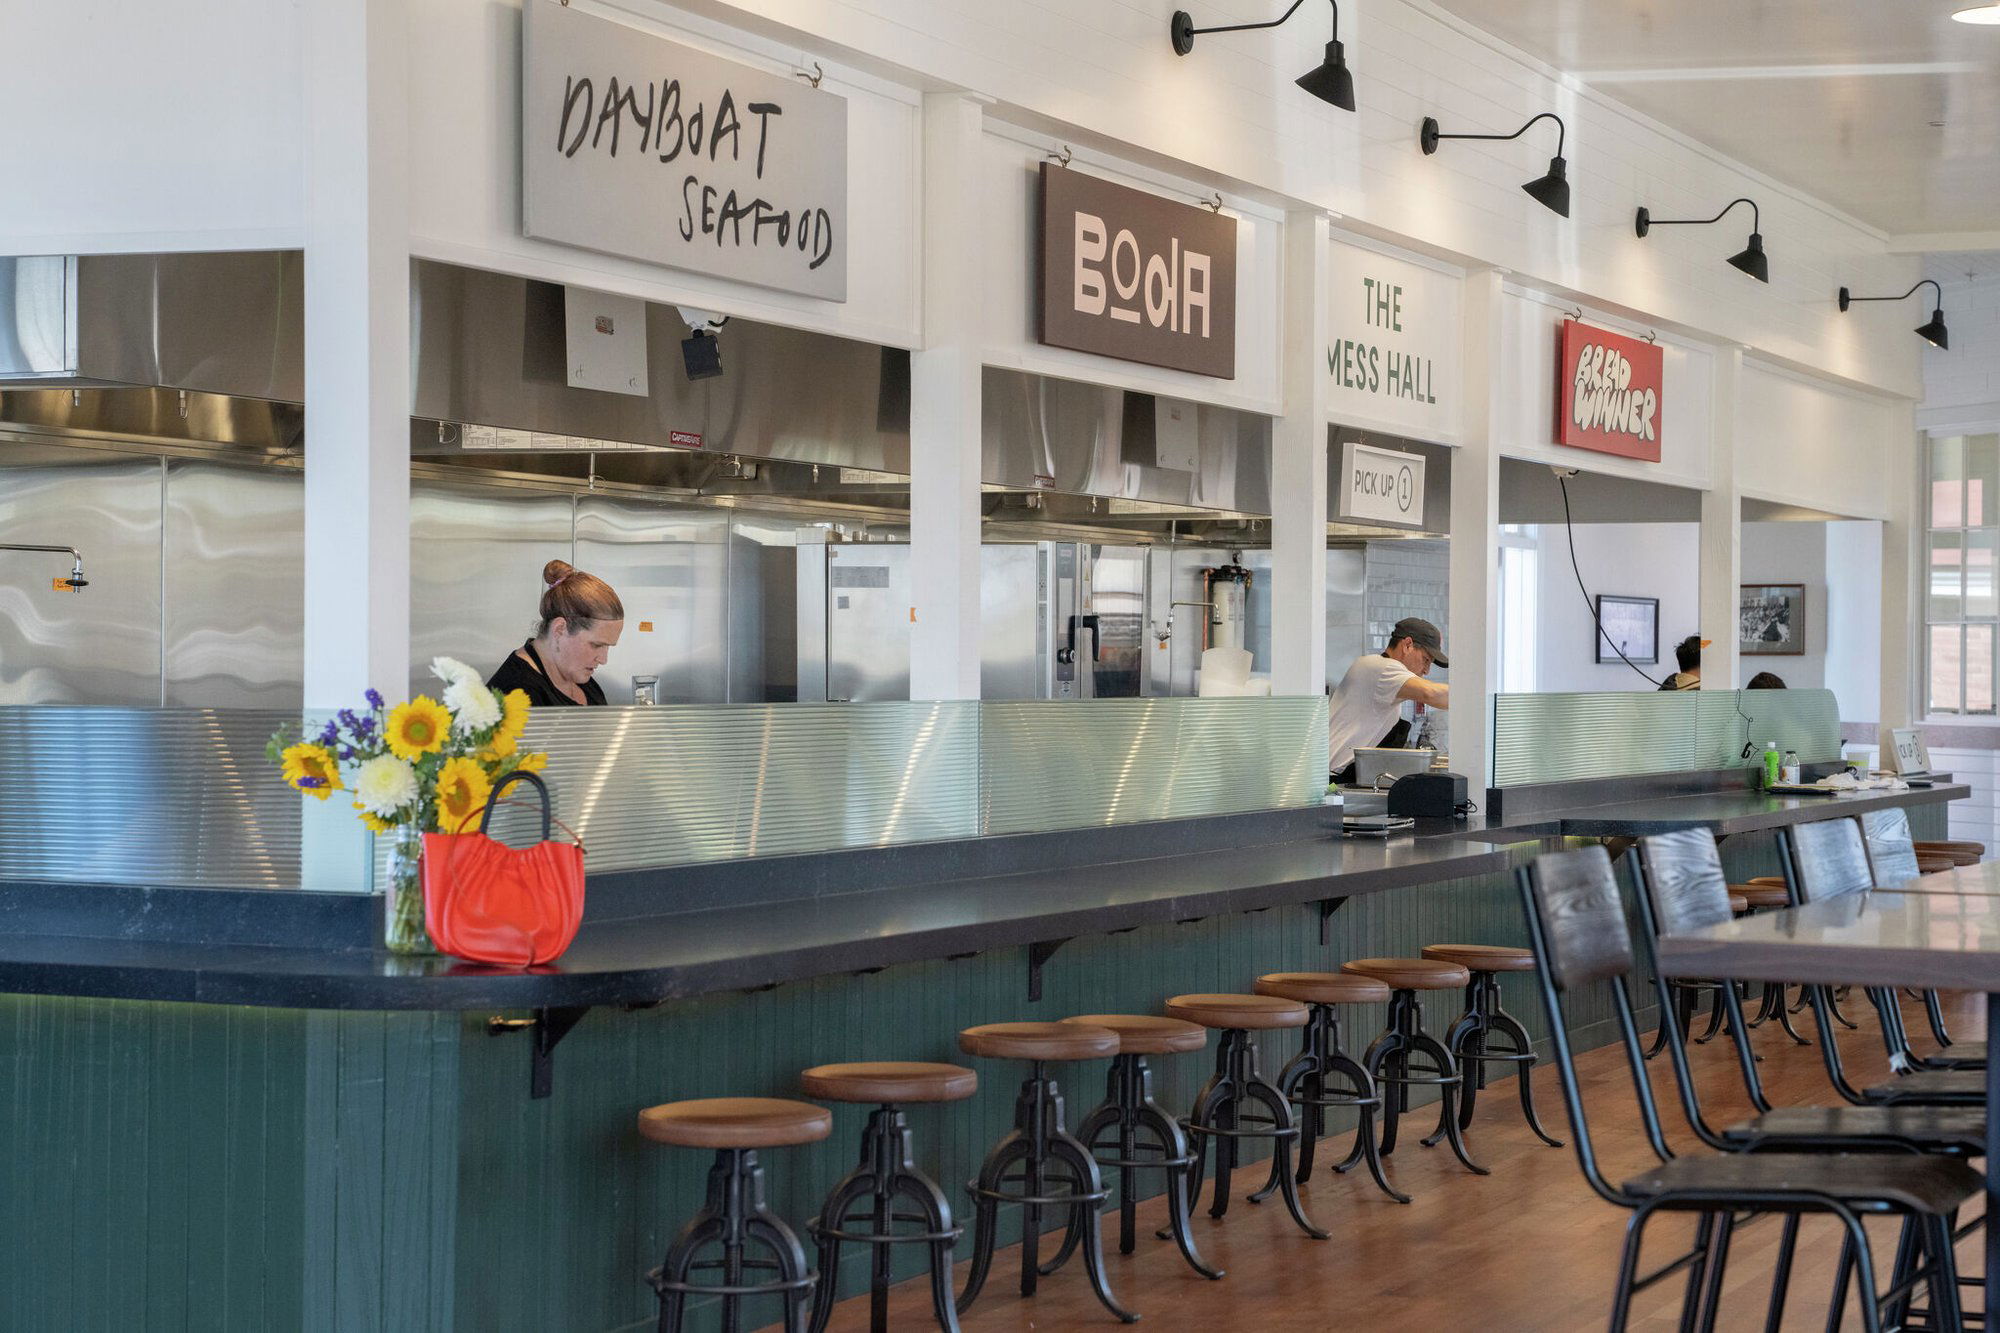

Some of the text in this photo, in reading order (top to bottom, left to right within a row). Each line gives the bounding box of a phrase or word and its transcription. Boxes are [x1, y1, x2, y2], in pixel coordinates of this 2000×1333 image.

[557, 75, 782, 179] DAYBOAT
[679, 175, 832, 270] SEAFOOD
[1364, 277, 1402, 332] THE
[1327, 338, 1436, 404] MESS HALL
[1574, 343, 1632, 392] BREAD
[1573, 378, 1657, 441] WINNER
[1355, 469, 1378, 495] PICK
[1381, 473, 1394, 497] UP
